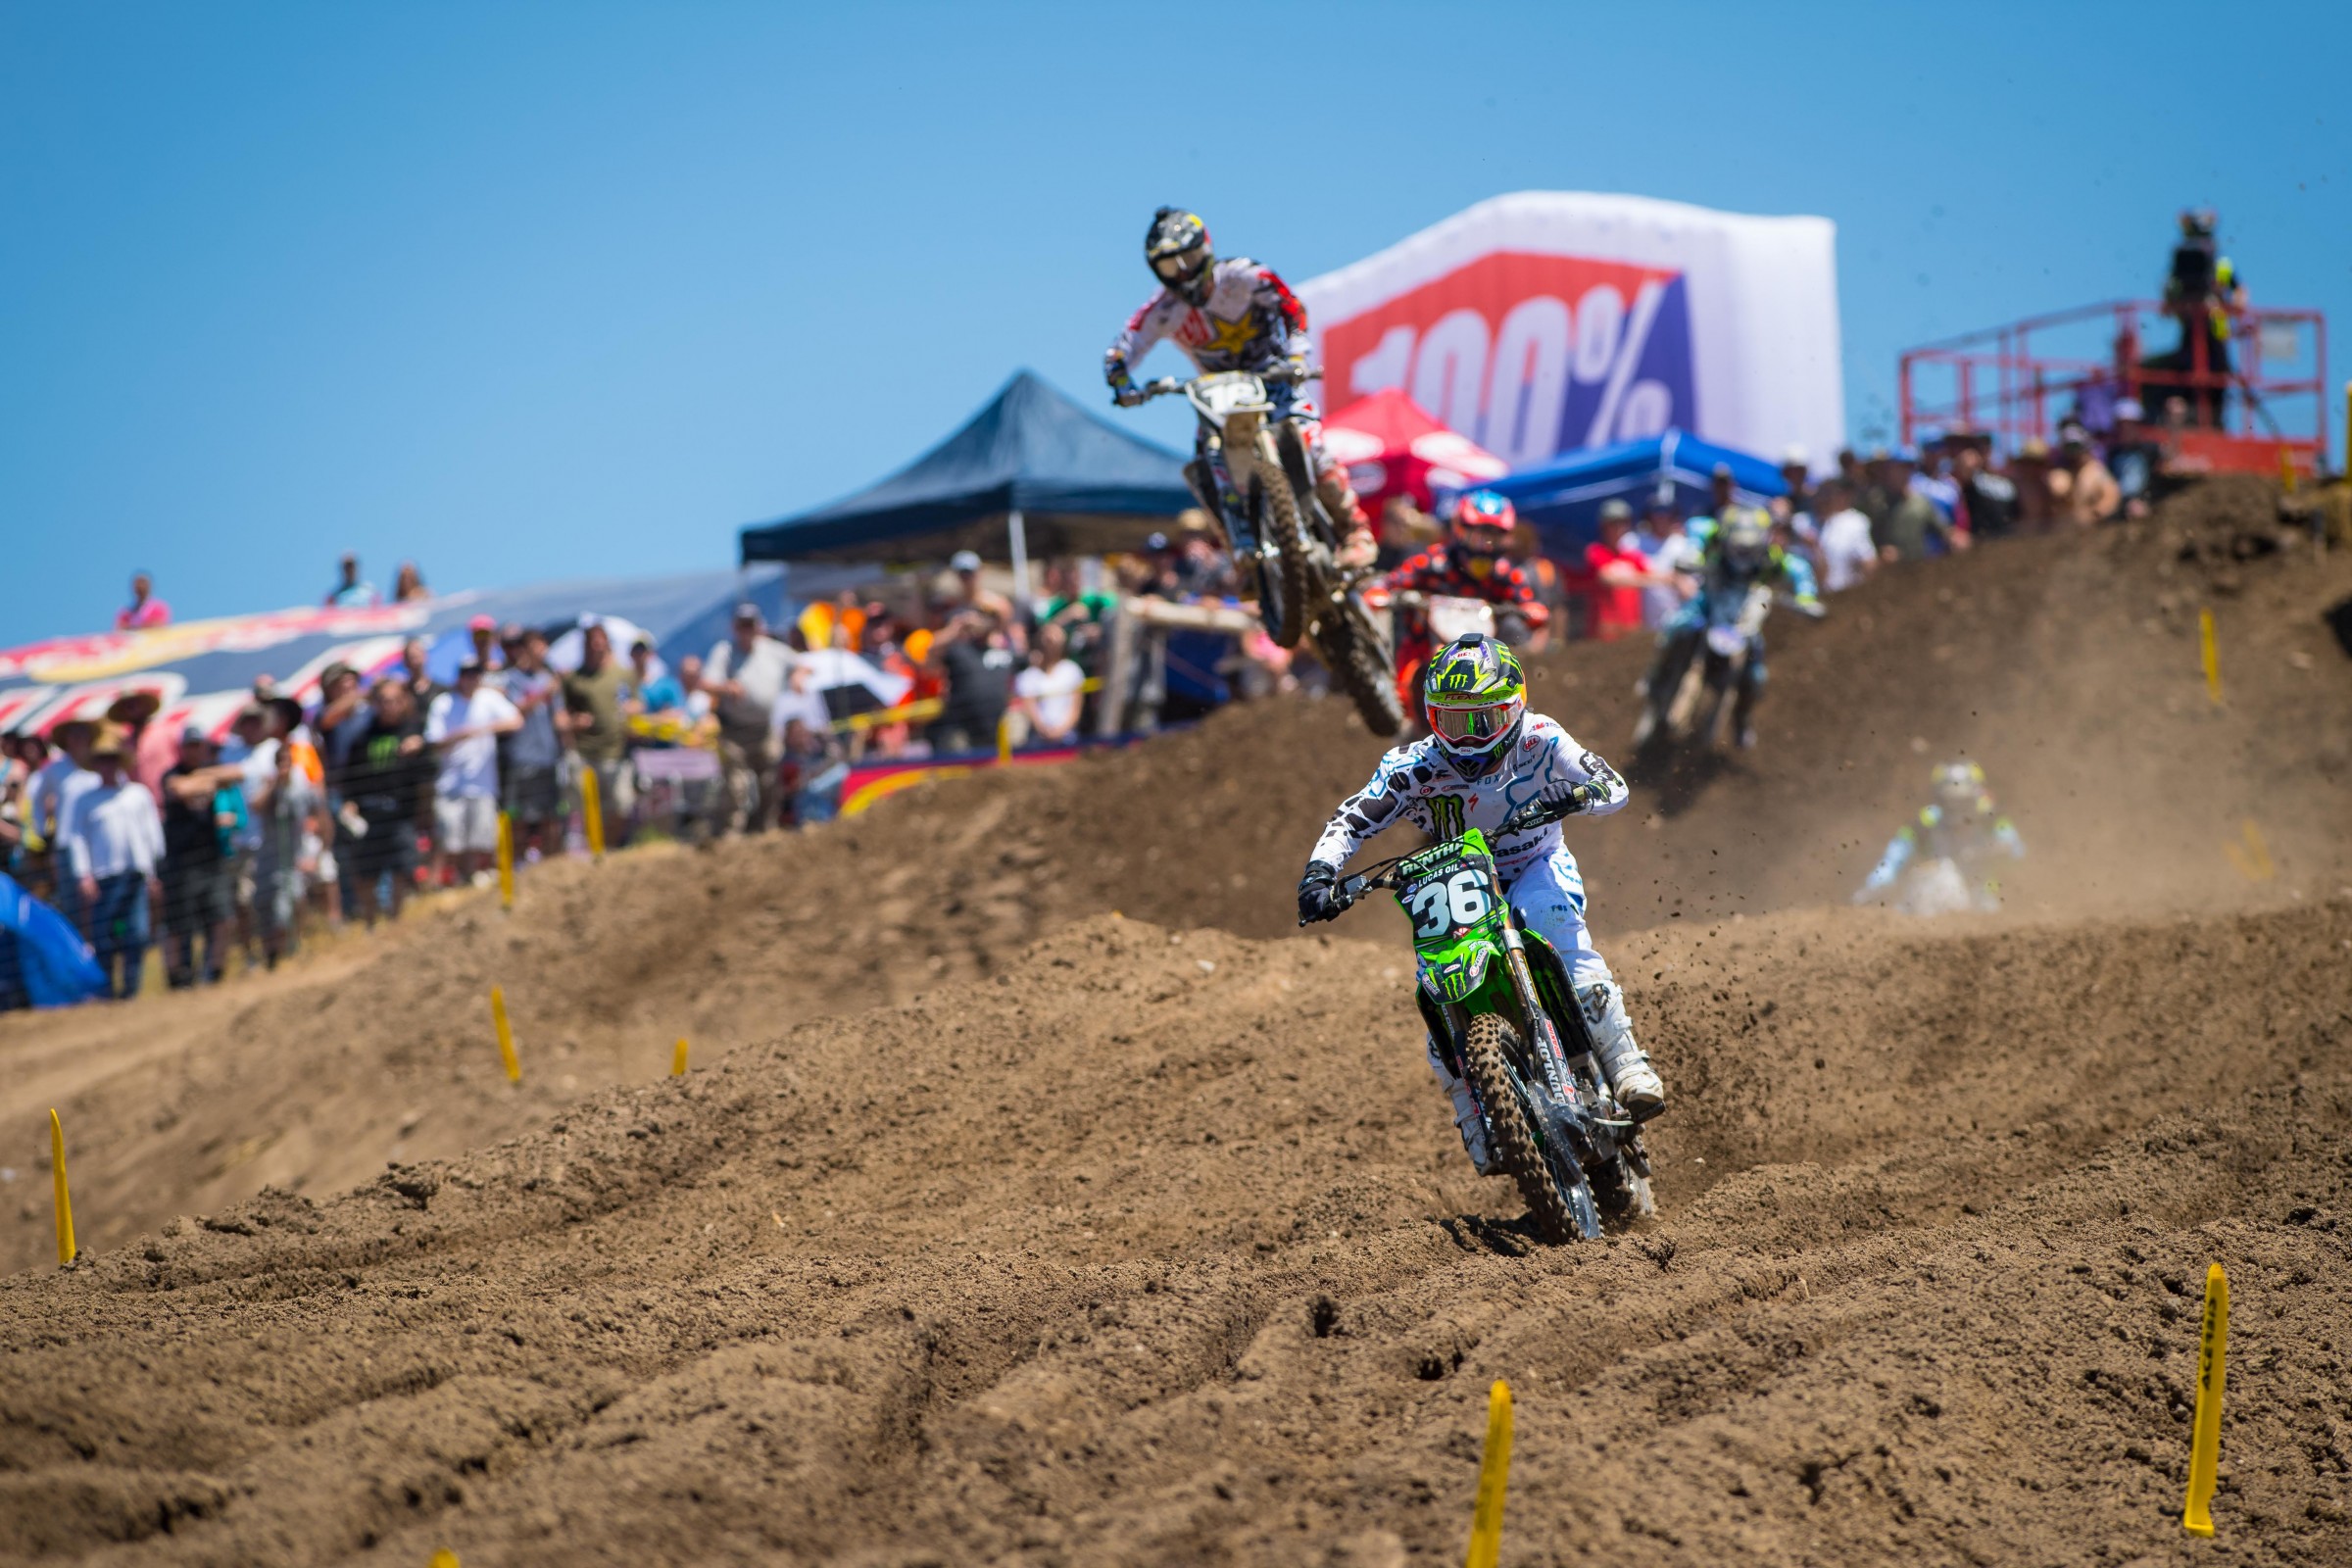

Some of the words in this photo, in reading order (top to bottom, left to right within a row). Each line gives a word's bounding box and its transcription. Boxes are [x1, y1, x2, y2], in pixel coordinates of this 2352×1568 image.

[1349, 276, 1674, 465] 100%
[1477, 773, 1500, 786] FOX
[1402, 839, 1464, 876] RENTHA
[1494, 827, 1548, 858] asaki
[1418, 868, 1444, 888] LUCAS
[1445, 863, 1460, 874] OIL
[1411, 868, 1491, 939] 36
[1537, 1036, 1566, 1104] DUNLOP
